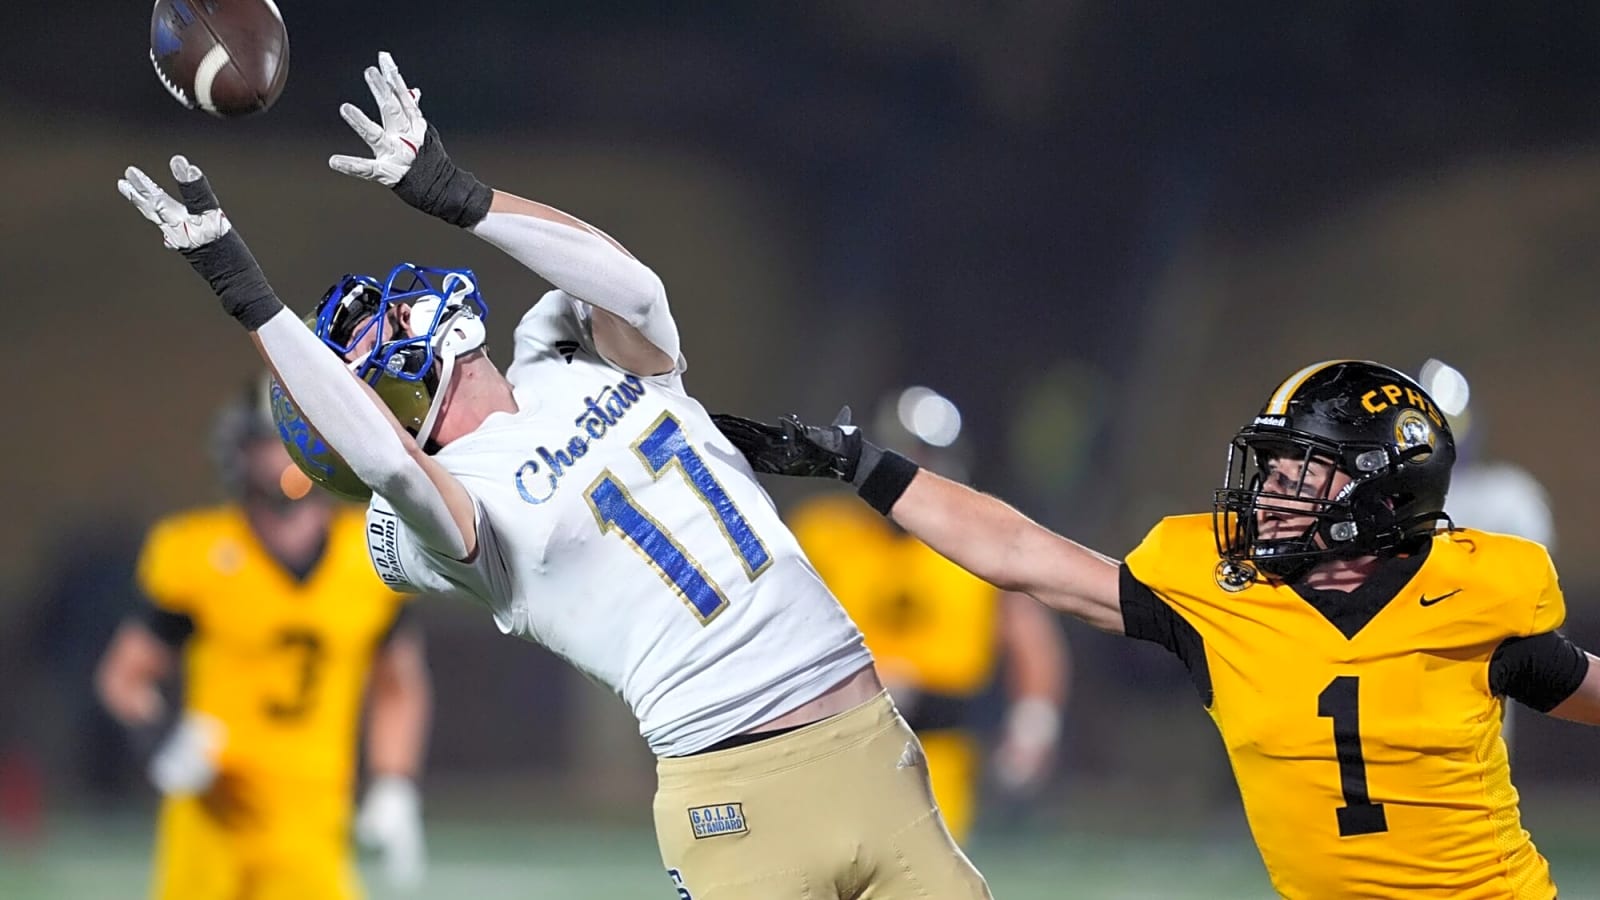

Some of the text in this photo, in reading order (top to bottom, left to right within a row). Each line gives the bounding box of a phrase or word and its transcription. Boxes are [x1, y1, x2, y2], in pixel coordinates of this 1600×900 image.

[515, 373, 646, 505] Choctaw
[583, 409, 774, 627] 17
[695, 818, 742, 835] STANDARD
[1317, 676, 1388, 837] 1
